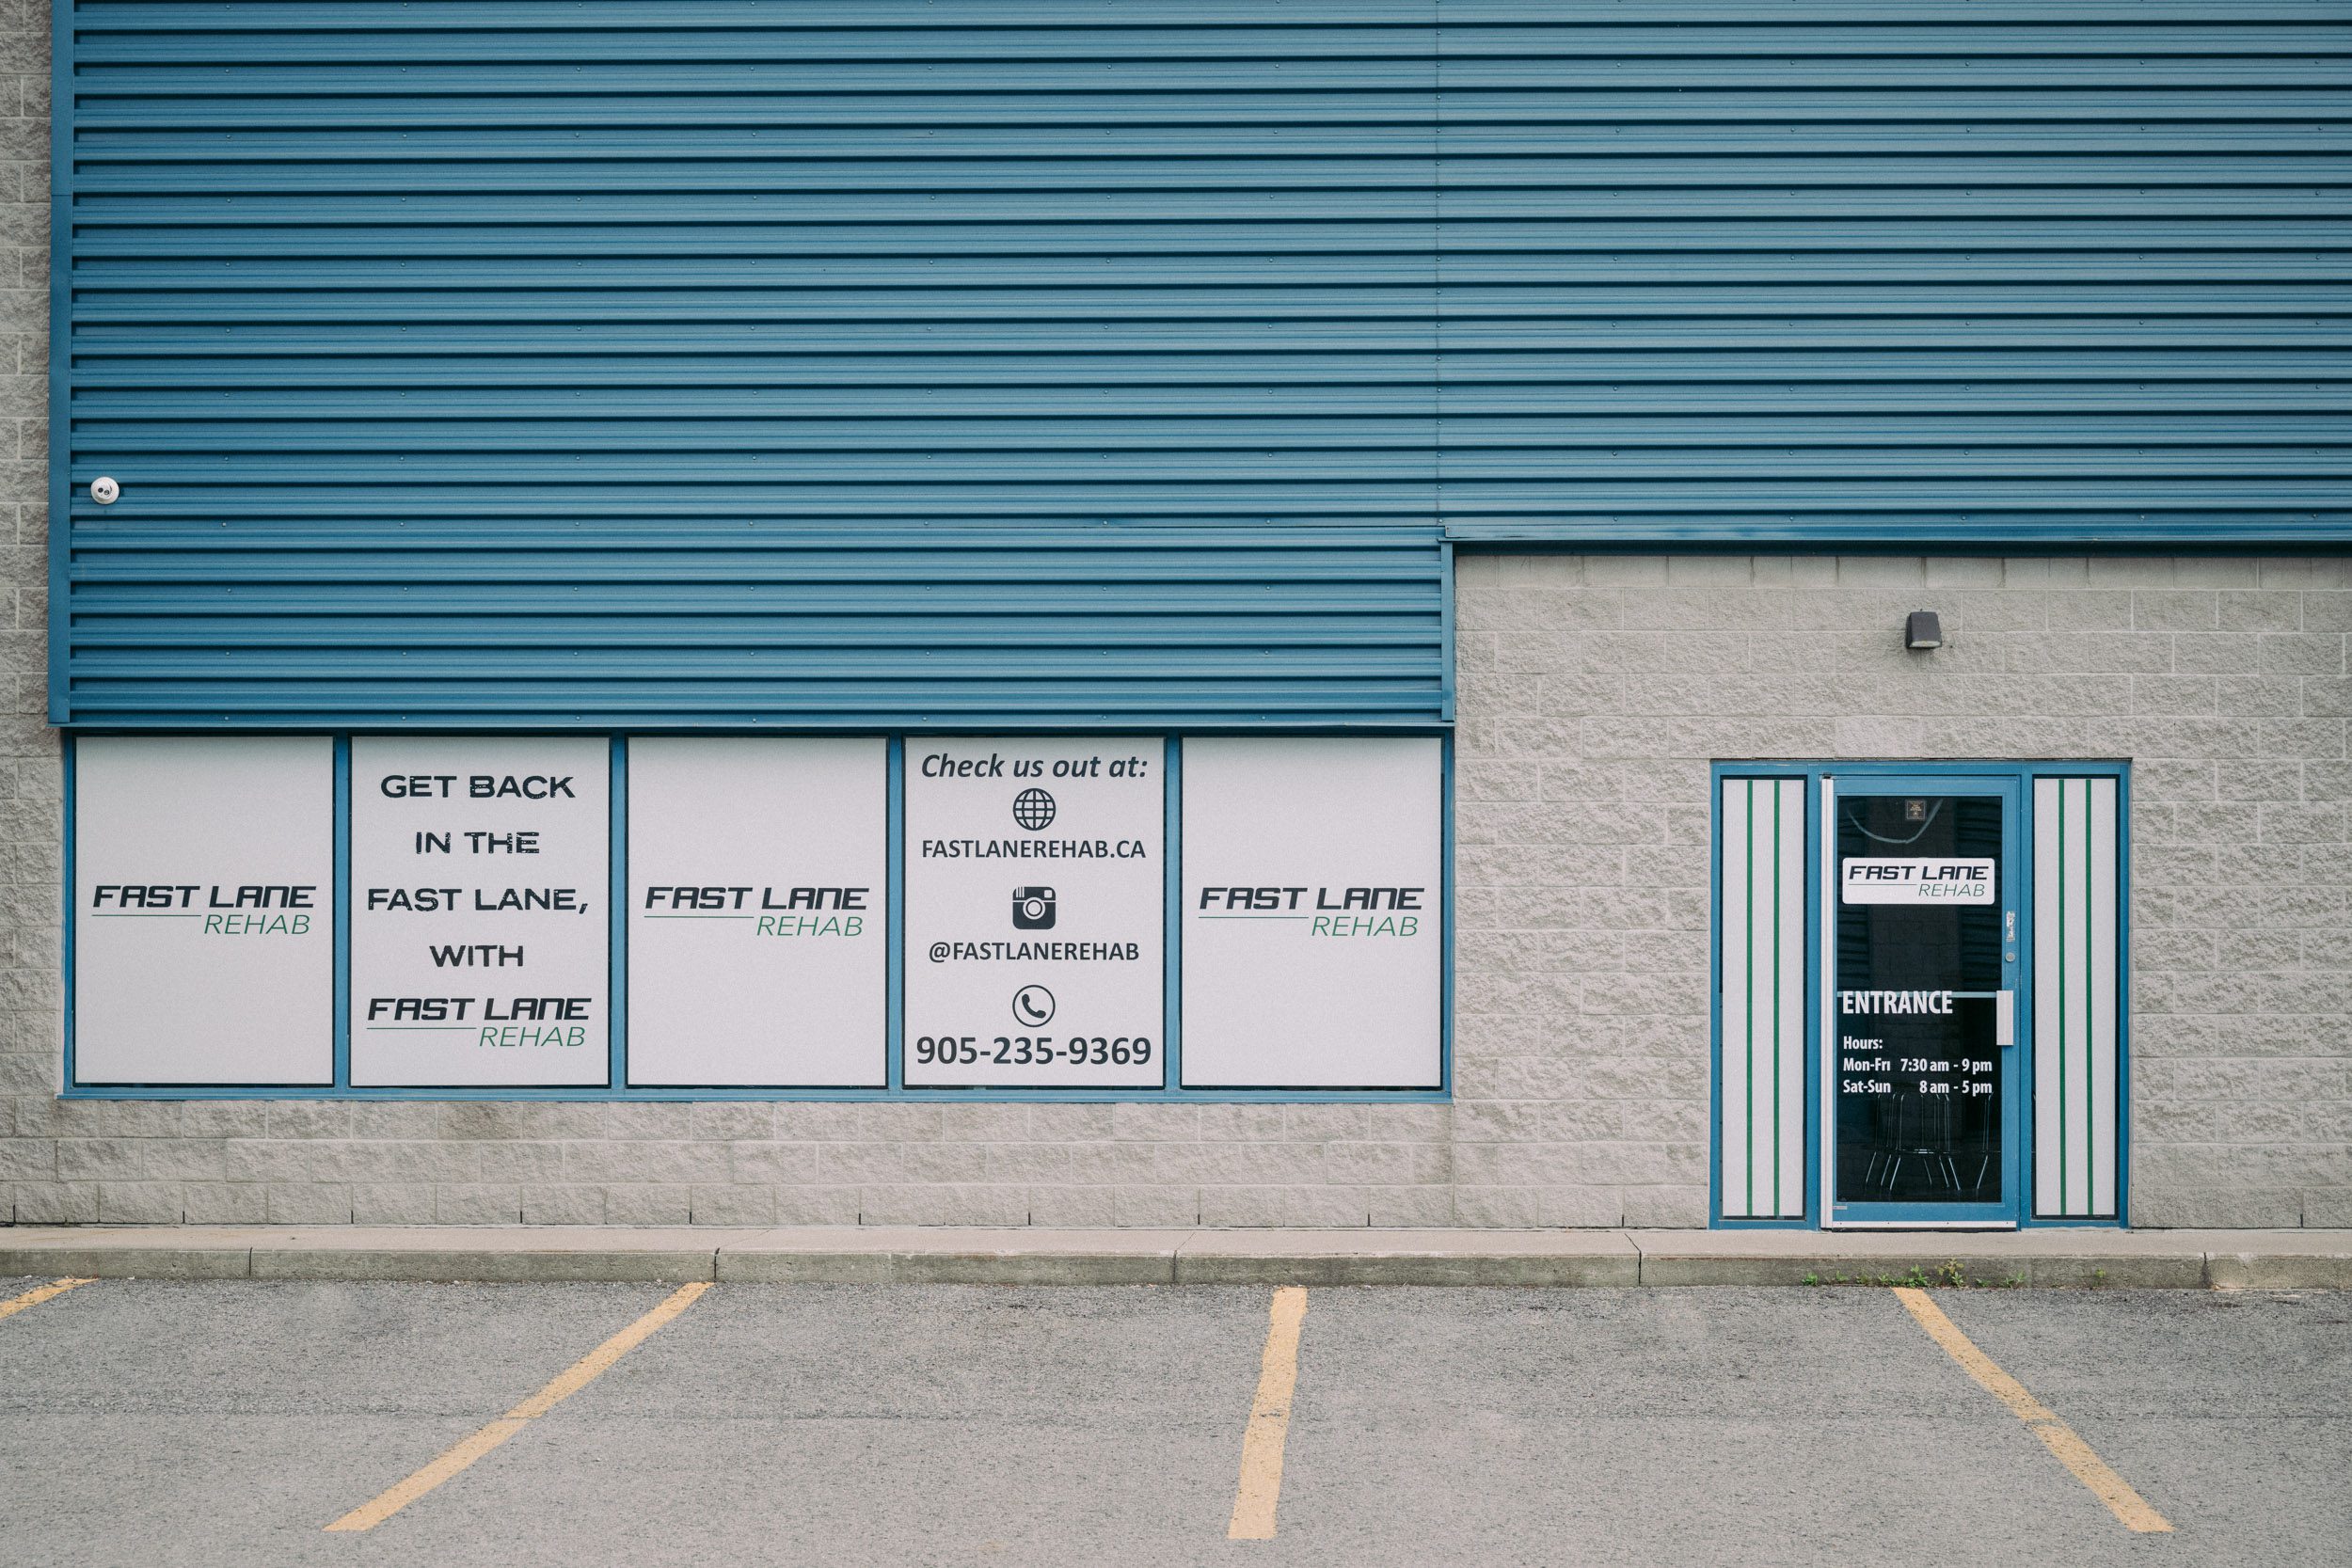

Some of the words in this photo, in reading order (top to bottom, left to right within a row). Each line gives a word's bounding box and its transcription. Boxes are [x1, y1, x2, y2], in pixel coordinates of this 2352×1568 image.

[921, 752, 1006, 778] Check
[1012, 759, 1044, 778] us
[1052, 755, 1102, 778] out
[1108, 755, 1148, 778] at:
[380, 774, 458, 799] GET
[469, 775, 577, 800] BACK
[415, 831, 452, 855] IN
[463, 831, 540, 855] THE
[922, 839, 1147, 859] FASTLANEREHAB.CA
[1848, 864, 1917, 880] FAST
[1920, 865, 1990, 881] LANE
[92, 884, 201, 909] FAST
[208, 885, 317, 909] LANE
[367, 887, 463, 912] FAST
[474, 888, 589, 915] LANE,
[644, 886, 754, 910] FAST
[761, 886, 870, 911] LANE
[1199, 886, 1309, 911] FAST
[1315, 887, 1425, 911] LANE
[1918, 883, 1985, 897] REHAB
[203, 913, 310, 935] REHAB
[756, 915, 864, 937] REHAB
[1311, 916, 1419, 937] REHAB
[428, 944, 524, 968] WITH
[929, 941, 1139, 964] @FASTLANEREHAB
[367, 997, 476, 1022] FAST
[484, 997, 593, 1022] LANE
[1842, 990, 1953, 1014] ENTRANCE
[479, 1026, 586, 1047] REHAB
[1843, 1036, 1883, 1050] Hours:
[916, 1036, 1152, 1066] 905-235-9369
[1843, 1057, 1891, 1071] Mon-Fri
[1899, 1057, 1928, 1072] 7:30
[1929, 1060, 1949, 1072] am
[1962, 1058, 1970, 1072] 9
[1972, 1061, 1993, 1075] pm
[1843, 1079, 1891, 1093] Sat-Sun
[1919, 1080, 1928, 1094] 8
[1929, 1083, 1949, 1094] am
[1962, 1080, 1970, 1094] 5
[1972, 1083, 1993, 1097] pm
